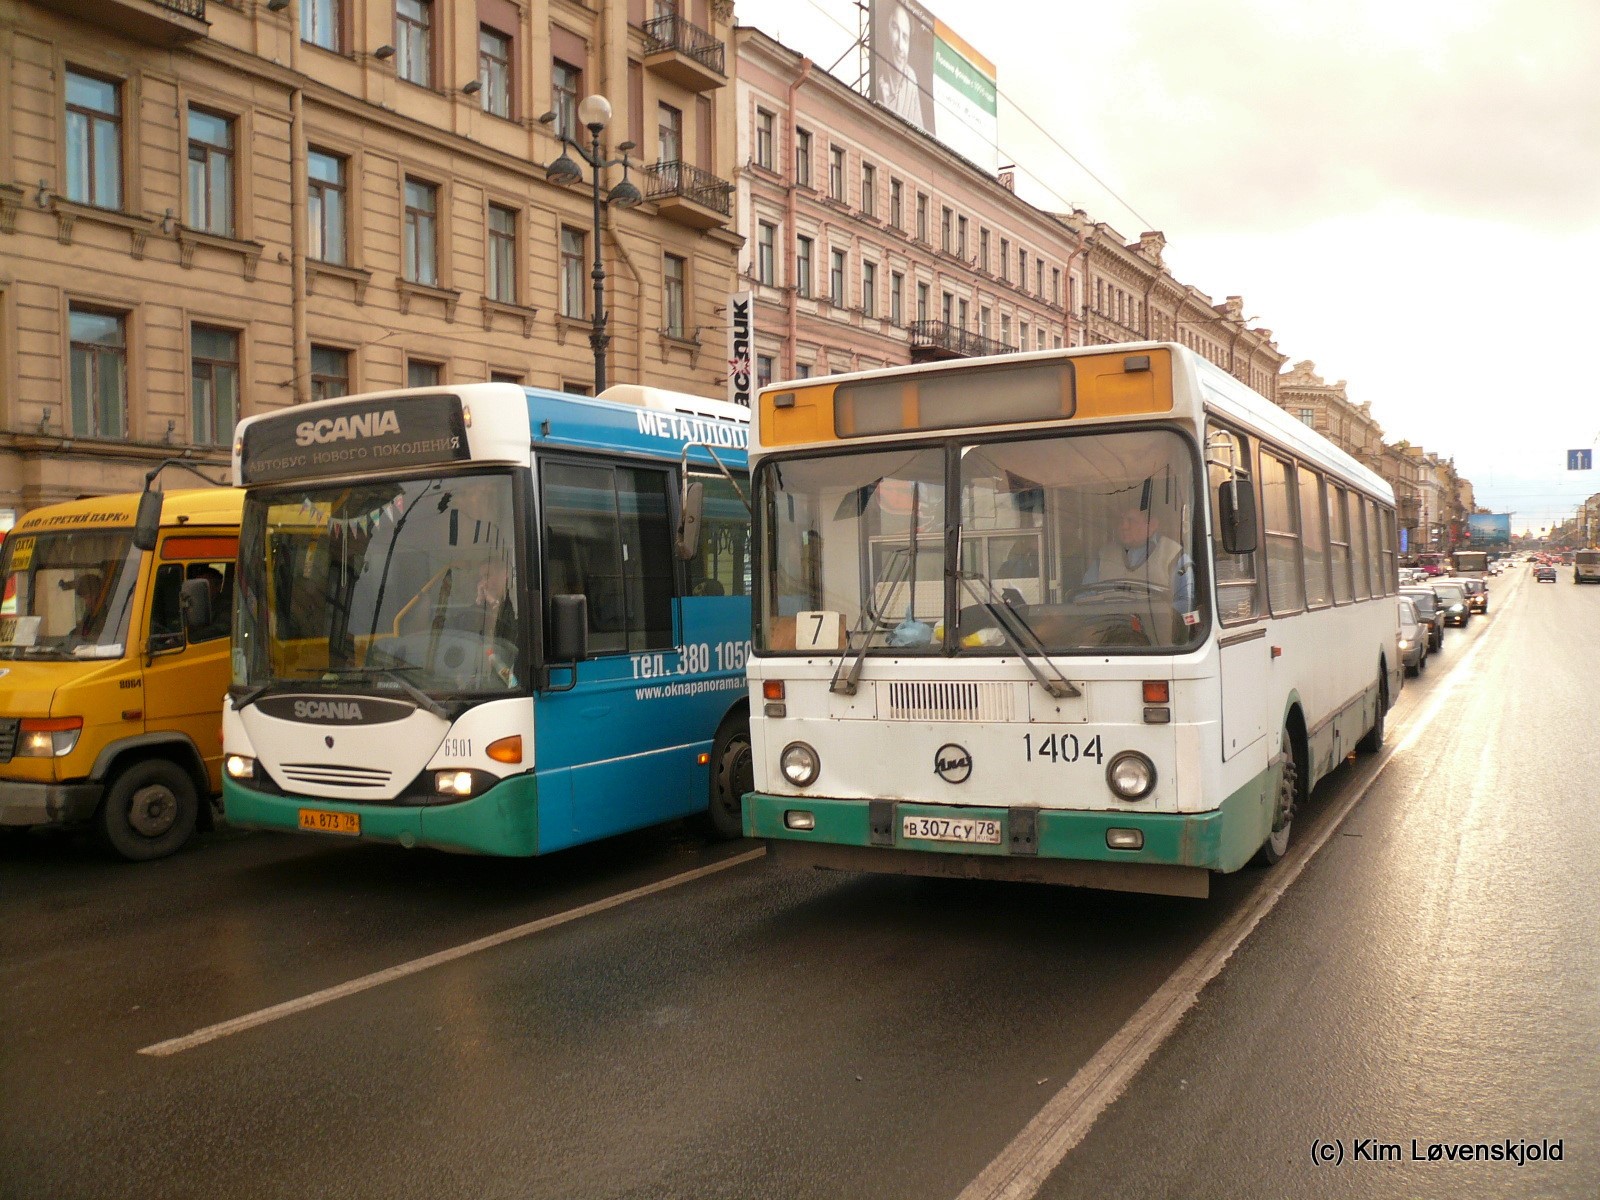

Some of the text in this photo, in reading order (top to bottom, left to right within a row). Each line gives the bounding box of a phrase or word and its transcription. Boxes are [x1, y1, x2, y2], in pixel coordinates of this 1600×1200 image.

[296, 410, 400, 446] SCANIA
[248, 436, 460, 473] АВТОБУС НОВОГО ПОКОЛЕНИЯ
[810, 614, 824, 645] 7
[630, 653, 671, 679] тел.
[675, 643, 709, 675] 380
[294, 701, 363, 720] SCANIA
[444, 739, 472, 757] 6901
[1023, 733, 1103, 765] 1404
[319, 813, 339, 829] 873
[977, 821, 995, 836] 78
